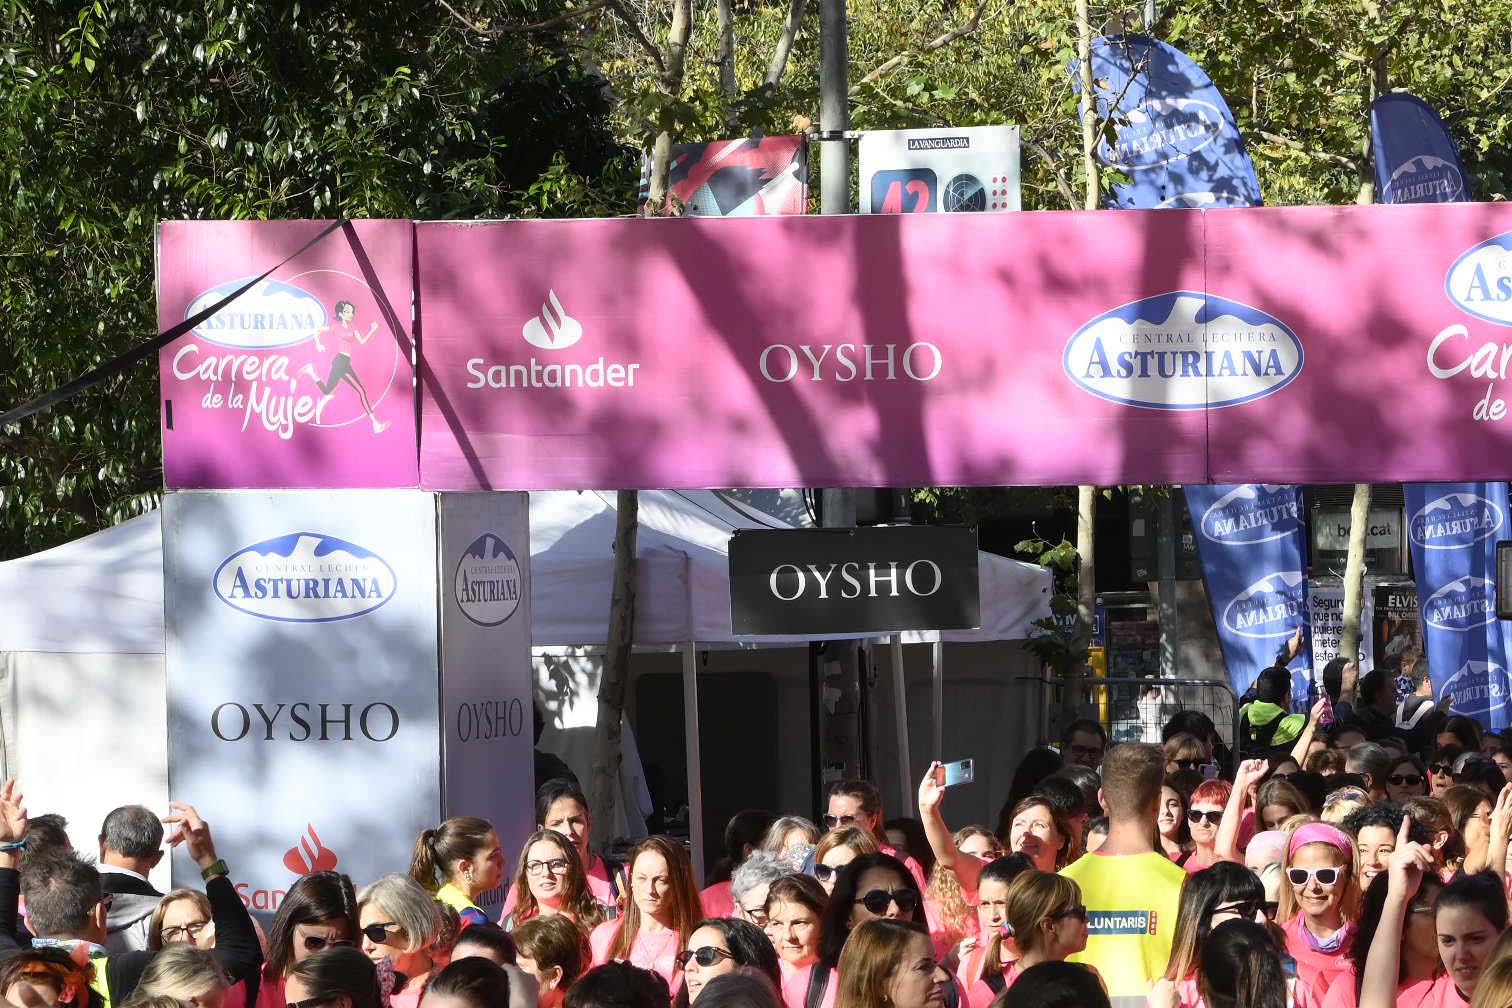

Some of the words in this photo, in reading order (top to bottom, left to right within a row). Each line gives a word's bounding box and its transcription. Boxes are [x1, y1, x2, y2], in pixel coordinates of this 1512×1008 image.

[919, 138, 969, 148] VANGUARDIA
[1118, 331, 1196, 345] CENTRAL
[1201, 331, 1278, 344] LECHERA
[173, 344, 289, 383] Carrera
[466, 356, 641, 390] Santander
[759, 342, 943, 383] OYSHO
[1083, 335, 1286, 381] ASTURIANA
[201, 383, 225, 409] de
[228, 383, 244, 409] la
[242, 378, 335, 440] Mujer
[1473, 384, 1506, 422] de
[227, 568, 384, 601] ASTURIANA
[461, 566, 519, 603] ASTURIANA
[769, 558, 943, 601] OYSHO
[1314, 652, 1334, 662] este
[210, 702, 401, 743] OYSHO
[457, 698, 523, 744] OYSHO
